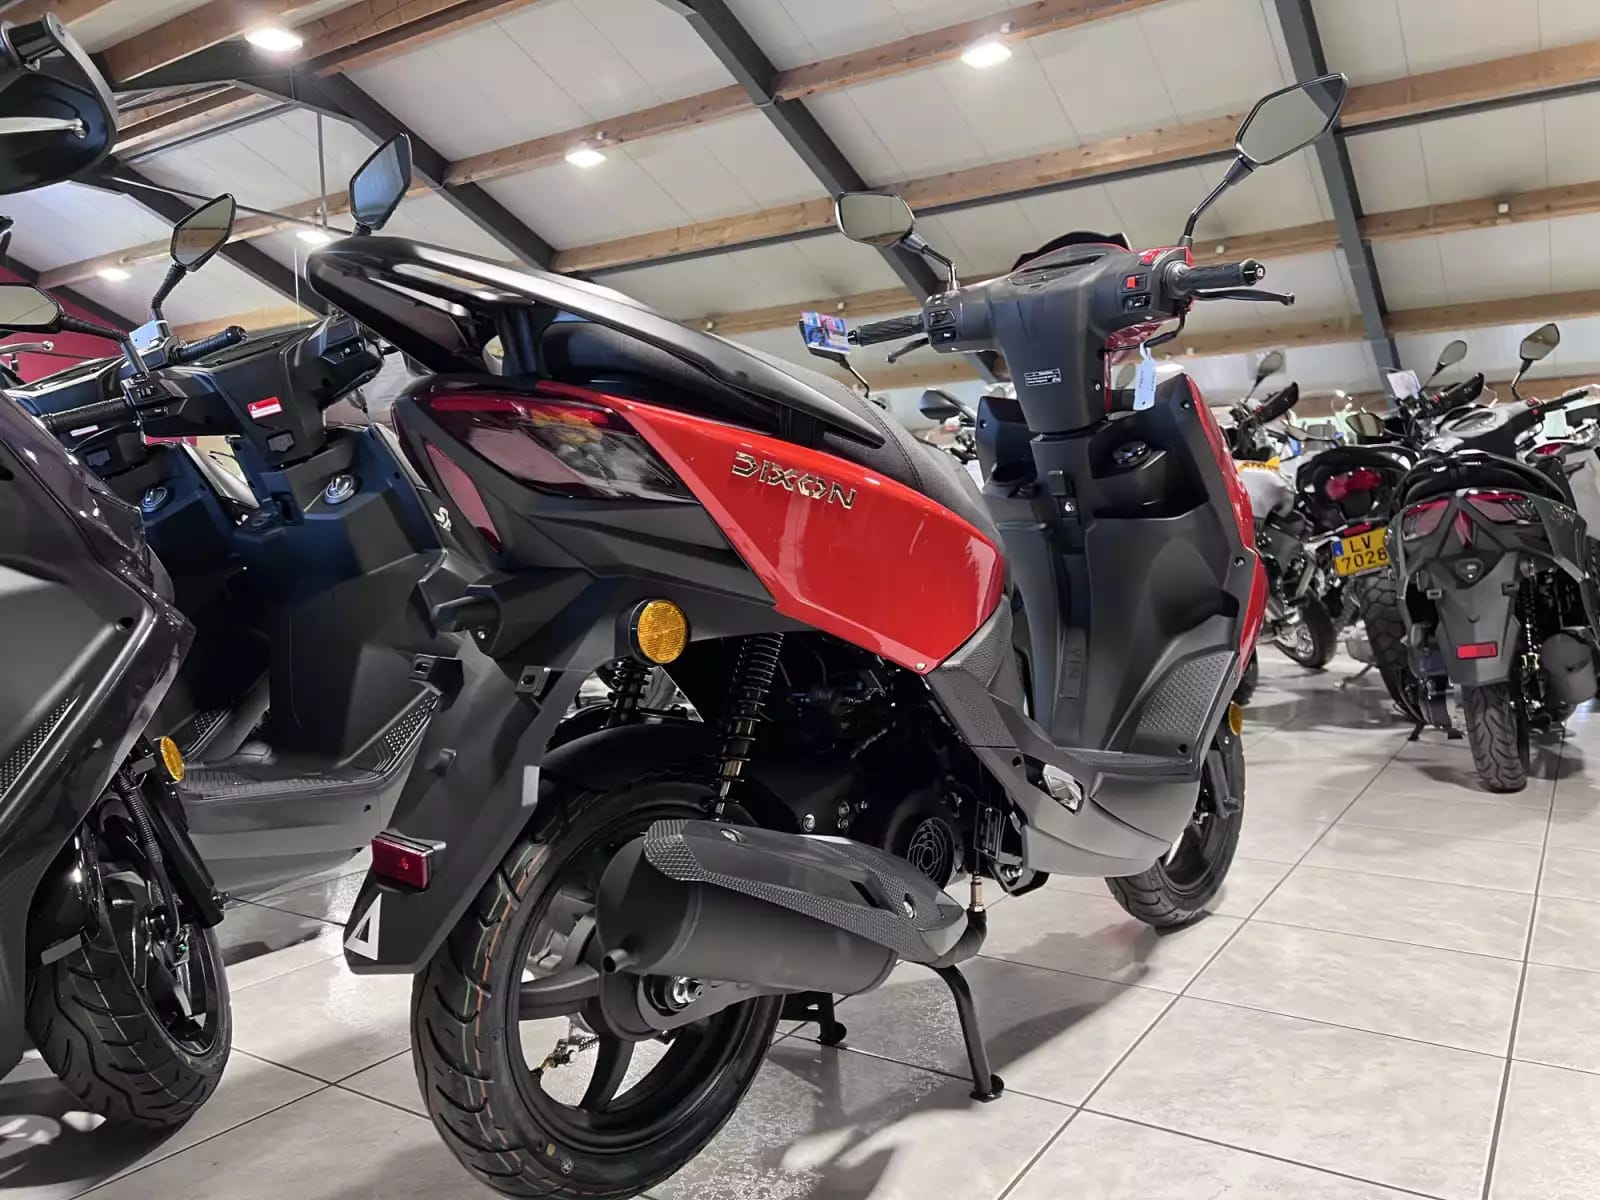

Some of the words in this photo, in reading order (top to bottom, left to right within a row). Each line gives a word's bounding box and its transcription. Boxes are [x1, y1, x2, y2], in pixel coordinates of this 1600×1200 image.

[731, 451, 857, 510] DIXON
[1349, 535, 1371, 553] LV
[1341, 547, 1387, 571] 7028
